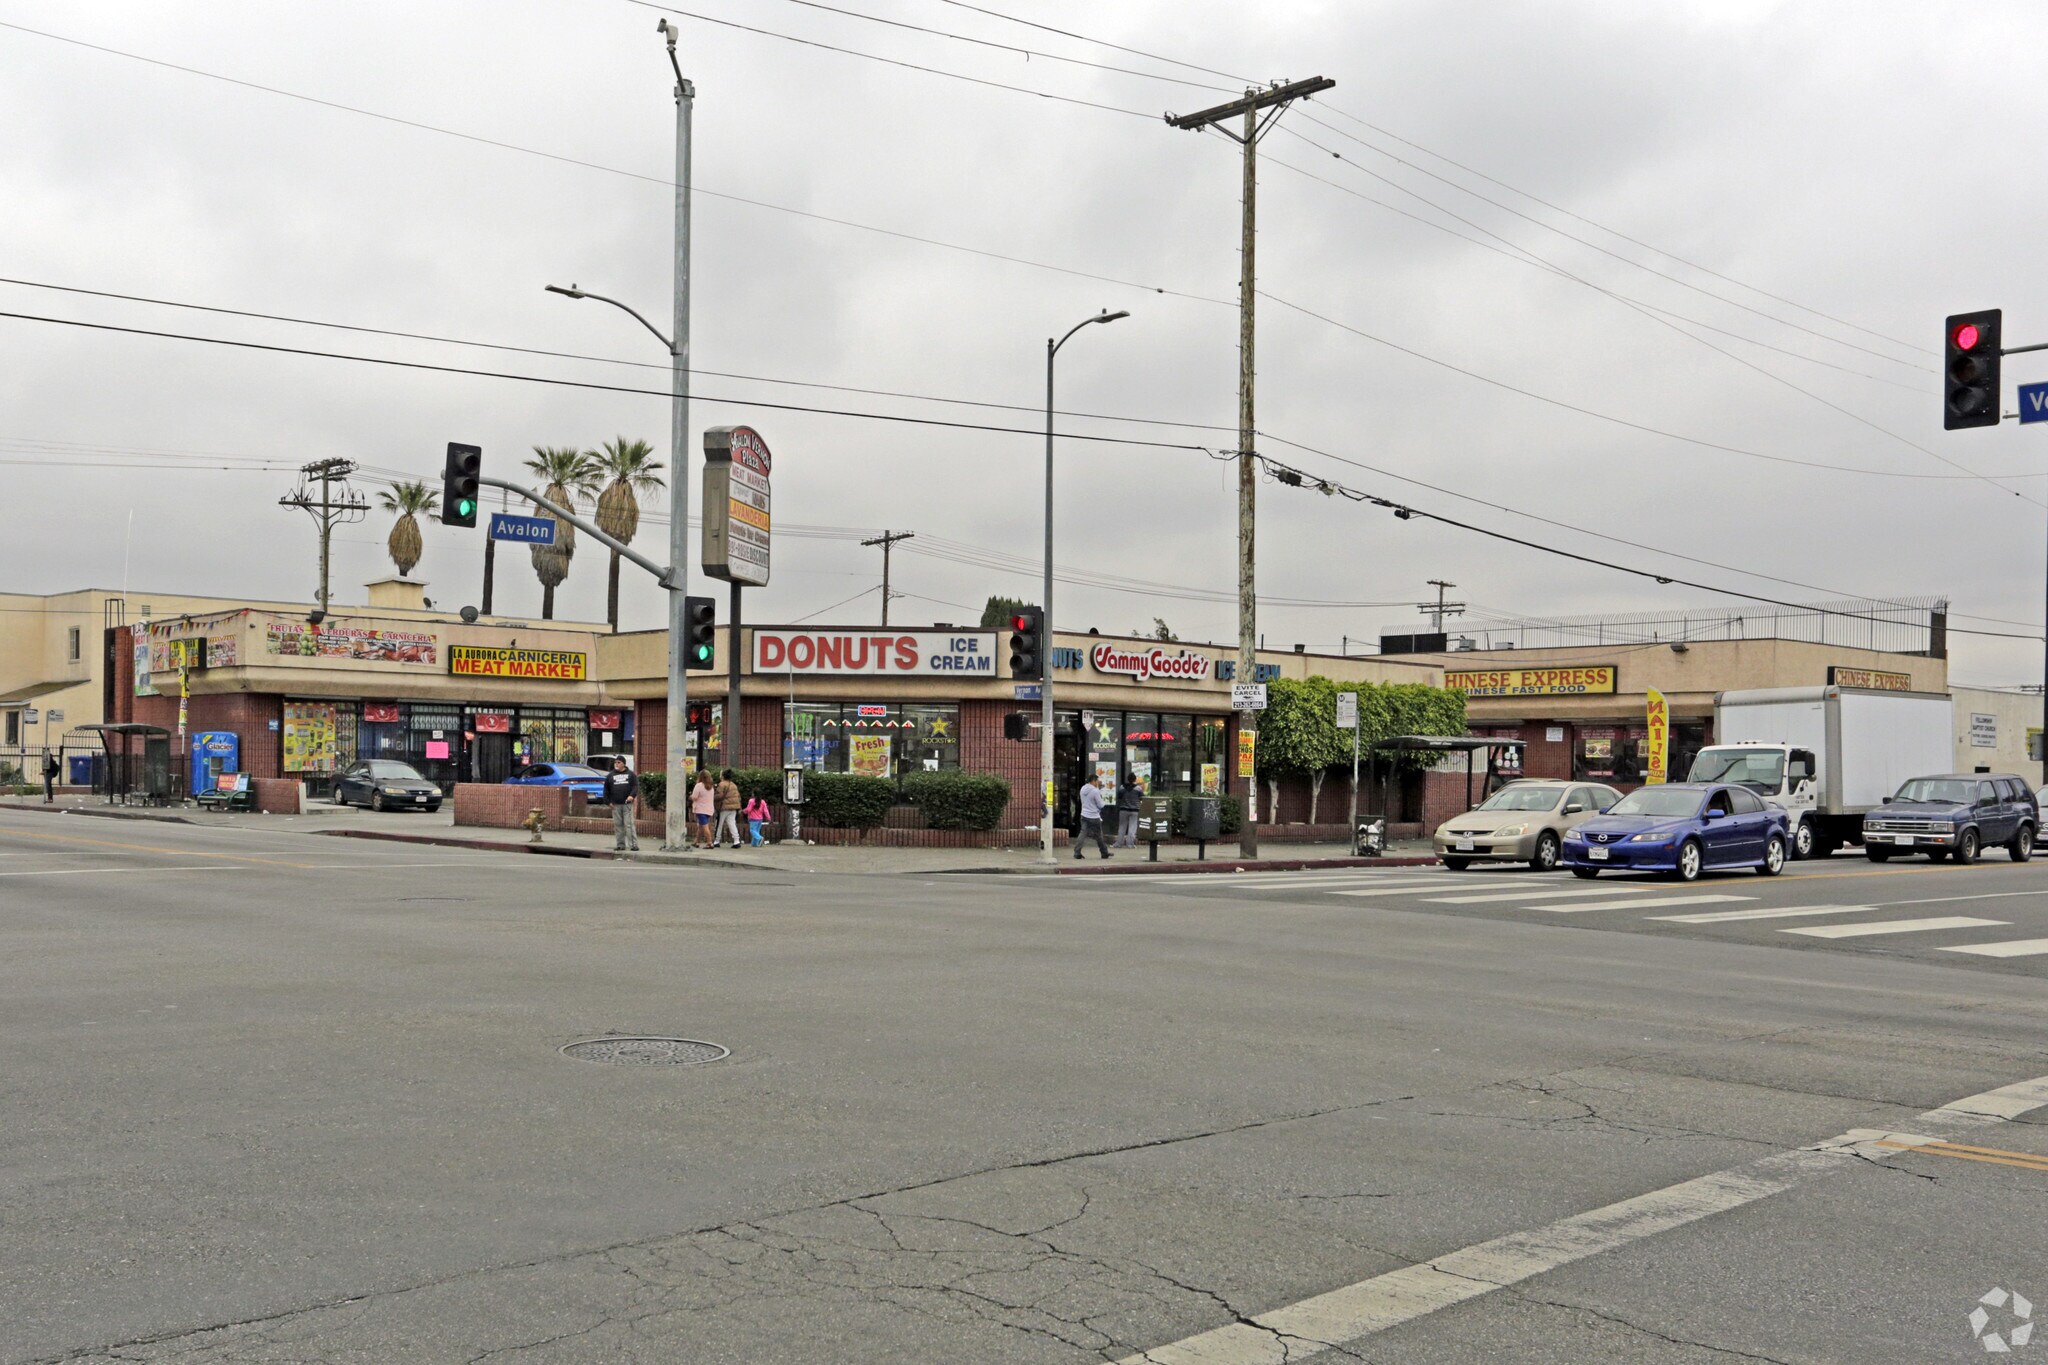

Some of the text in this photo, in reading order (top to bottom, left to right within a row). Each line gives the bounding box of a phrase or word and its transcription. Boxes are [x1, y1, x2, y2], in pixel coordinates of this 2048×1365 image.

[2029, 391, 2048, 412] V
[732, 465, 767, 491] MEAT MARKET
[729, 502, 769, 528] LAVANDERIA
[496, 520, 549, 538] Avalon
[270, 624, 432, 642] FRUTAS VERDURAS CARNICERIA
[453, 648, 582, 664] LA AURORA CARNICERIA
[760, 635, 978, 669] DONUTS ICE
[1052, 647, 1083, 669] NUTS
[1096, 646, 1209, 676] Sammy Goode's
[455, 658, 582, 678] MEAT MARKET
[930, 655, 990, 670] CREAM
[1216, 660, 1281, 682] ICE EAM
[1444, 668, 1608, 689] HINESE EXPRESS
[1835, 669, 1909, 691] CHINESE EXPRESS
[1465, 685, 1586, 695] HINESE FAST FOOD
[860, 706, 885, 715] OPEN
[207, 742, 233, 751] Glacier
[855, 738, 885, 751] Fresh
